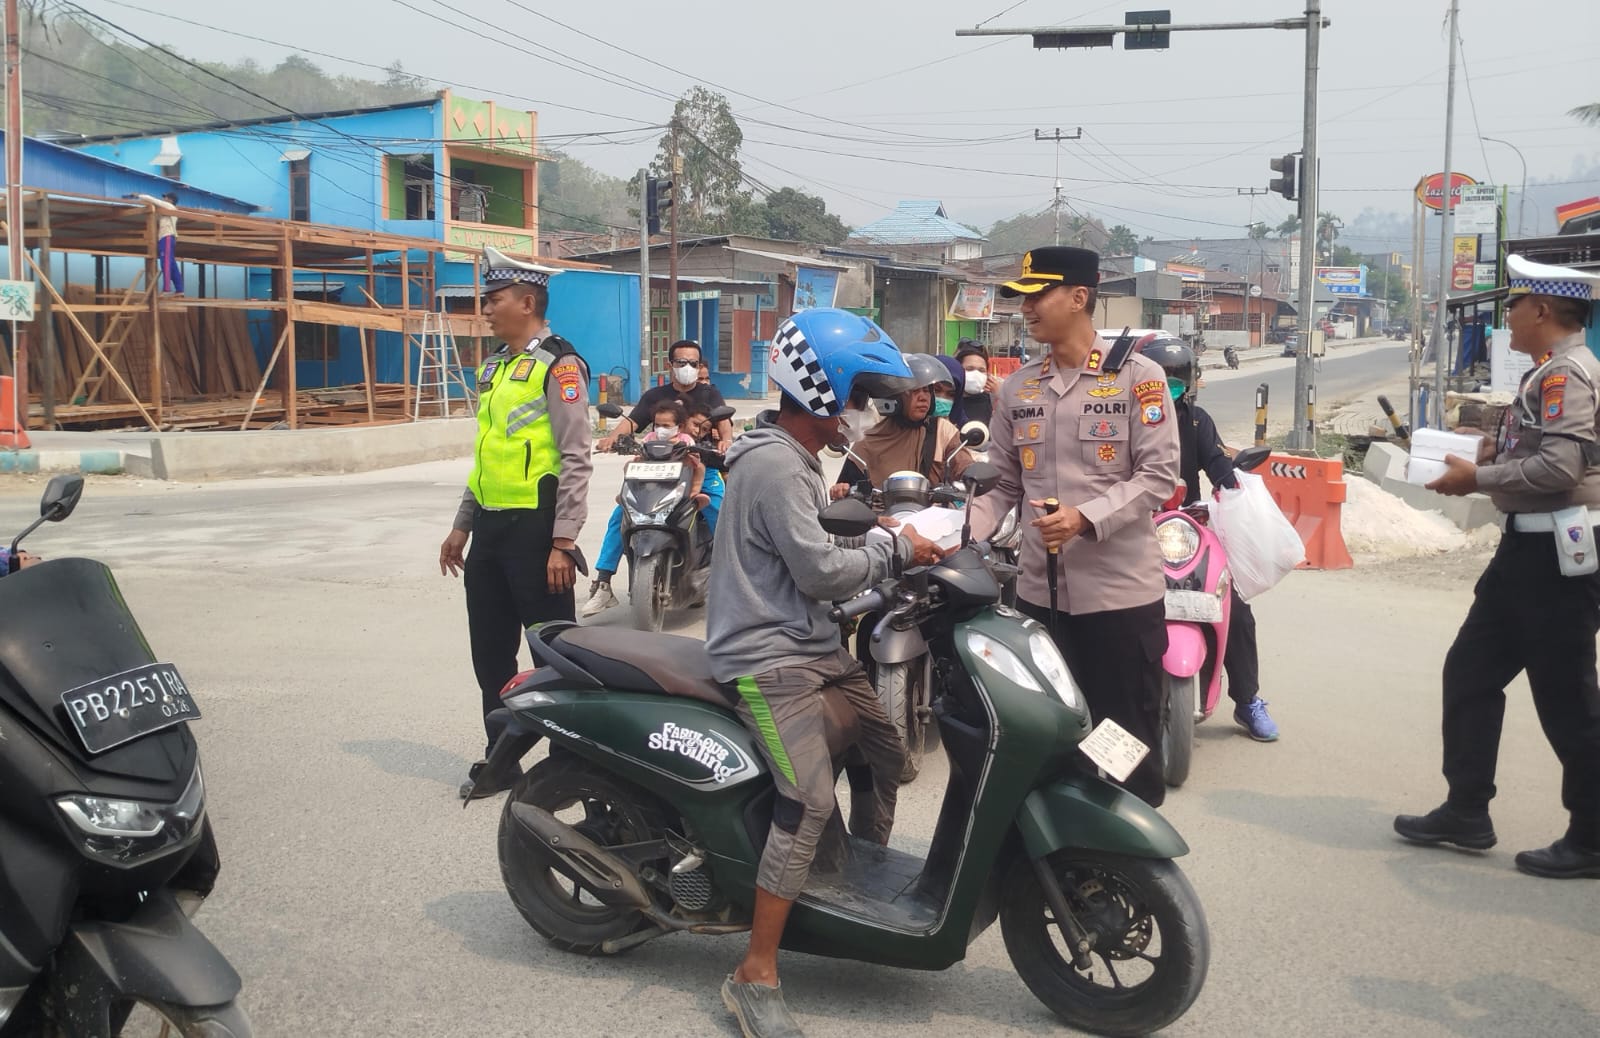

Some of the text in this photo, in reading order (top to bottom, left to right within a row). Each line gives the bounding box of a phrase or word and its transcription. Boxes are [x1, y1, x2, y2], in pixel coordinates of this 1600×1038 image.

[1084, 403, 1126, 415] POLRI
[70, 670, 188, 728] PB 2251 RA
[542, 718, 582, 740] Genio
